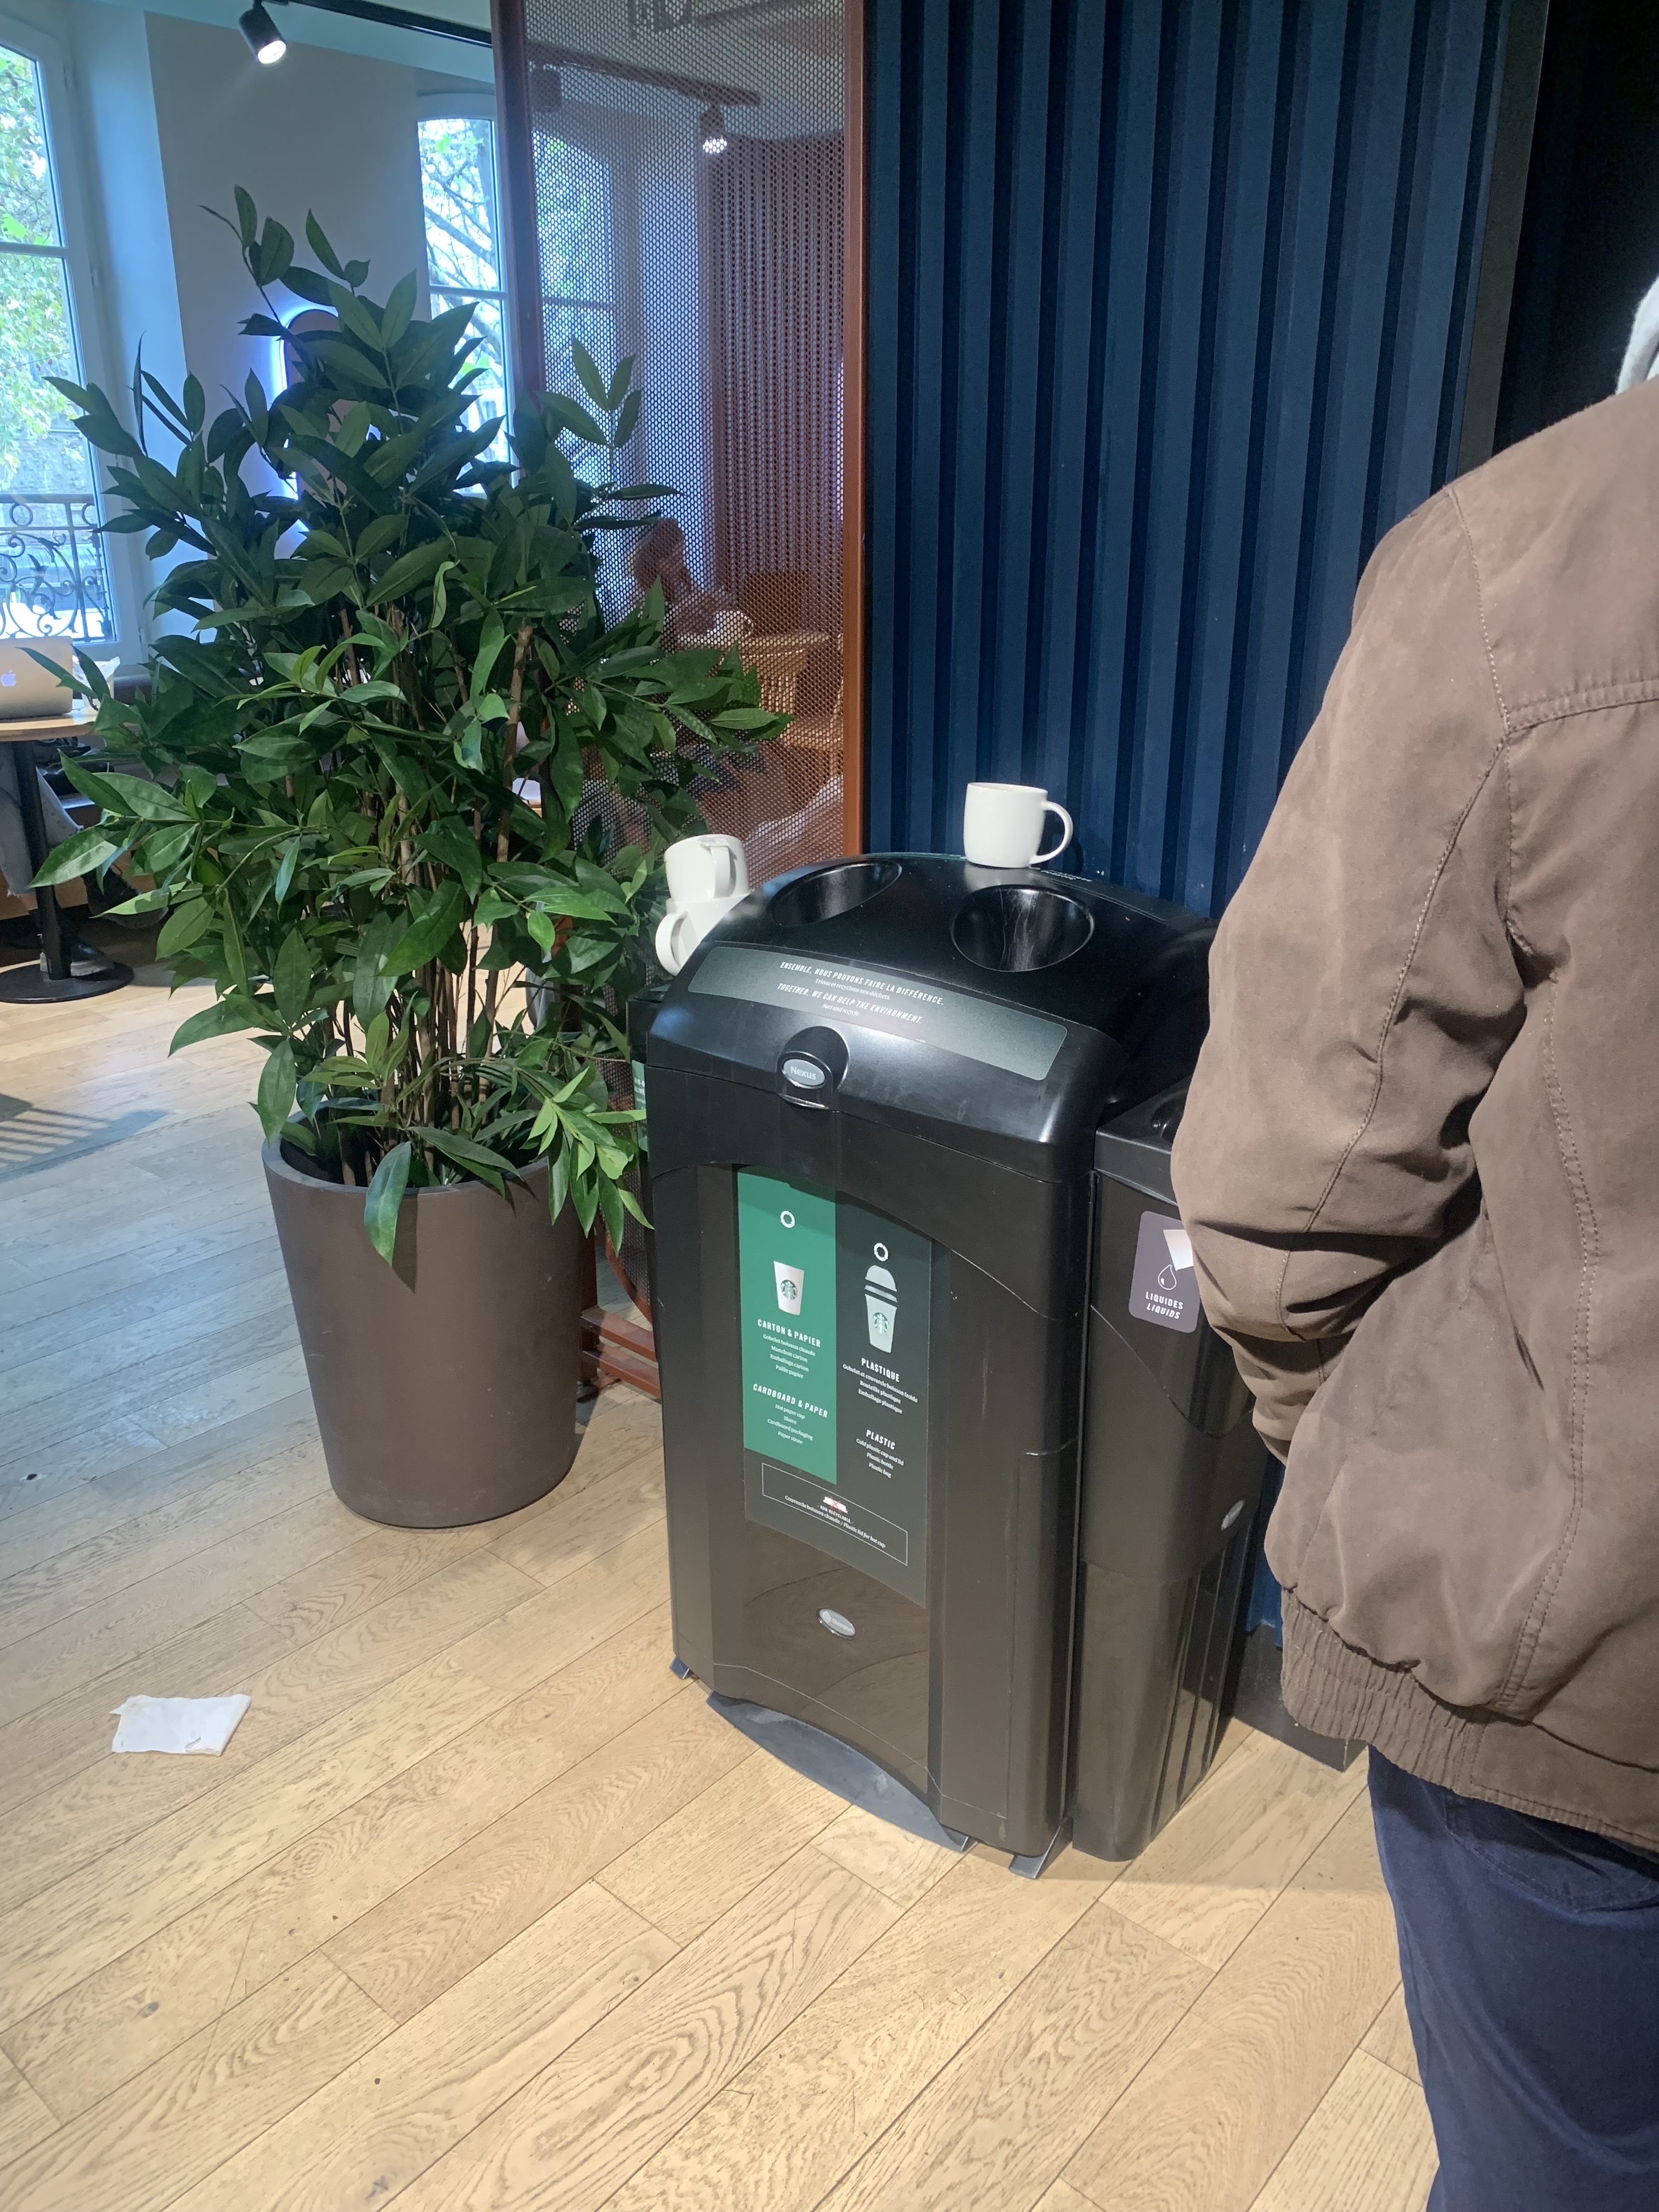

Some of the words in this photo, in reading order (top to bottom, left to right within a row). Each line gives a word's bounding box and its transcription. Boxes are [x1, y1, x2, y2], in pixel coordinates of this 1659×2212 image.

[780, 962, 811, 974] ENSEMBLE,
[814, 968, 832, 977] NOUS
[832, 972, 864, 984] POUVONS
[864, 979, 885, 989] FAIRE
[896, 987, 943, 1005] DIFFÉRENCE.
[836, 984, 859, 992] recyclons
[870, 991, 890, 1000] déchets.
[777, 983, 809, 996] TOGETHER,
[823, 993, 837, 1002] CAN
[837, 996, 855, 1005] HELP
[856, 1001, 870, 1009] THE
[870, 1005, 922, 1023] ENVIRONMENT.
[791, 1066, 816, 1080] Nexus
[1146, 1291, 1183, 1310] LIQUIDES
[1147, 1303, 1181, 1319] LIQUIDS
[758, 1319, 785, 1334] CARTON
[794, 1331, 820, 1347] PAPIER
[763, 1334, 780, 1344] Gobelet
[781, 1340, 798, 1350] boisson
[799, 1347, 815, 1356] chaude
[771, 1346, 792, 1357] Manchon
[793, 1353, 808, 1363] carton
[770, 1354, 794, 1366] Emballage
[794, 1363, 809, 1372] carton
[776, 1365, 788, 1373] Paille
[789, 1370, 803, 1378] papier
[861, 1358, 900, 1382] PLASTIQUE
[843, 1364, 860, 1375] Gobelet
[865, 1374, 887, 1387] couvercle
[887, 1383, 904, 1396] boisson
[904, 1392, 918, 1403] froide
[860, 1380, 880, 1393] Bouteille
[881, 1390, 901, 1404] plastique
[753, 1384, 795, 1404] CARDBOARD
[805, 1403, 828, 1418] PAPER
[859, 1389, 881, 1403] Emballage
[882, 1401, 902, 1414] plastique
[768, 1419, 791, 1431] Cardboard
[856, 1438, 866, 1447] Cold
[866, 1443, 881, 1454] plastic
[866, 1430, 895, 1449] PLASTIC
[867, 1452, 881, 1463] Plastic
[881, 1459, 893, 1469] bottle
[869, 1463, 883, 1473] Plastic
[785, 1496, 806, 1508] Couvercle
[807, 1504, 823, 1516] boisson
[844, 1522, 857, 1533] Plastic
[829, 1509, 850, 1523] RECYCLABLE
